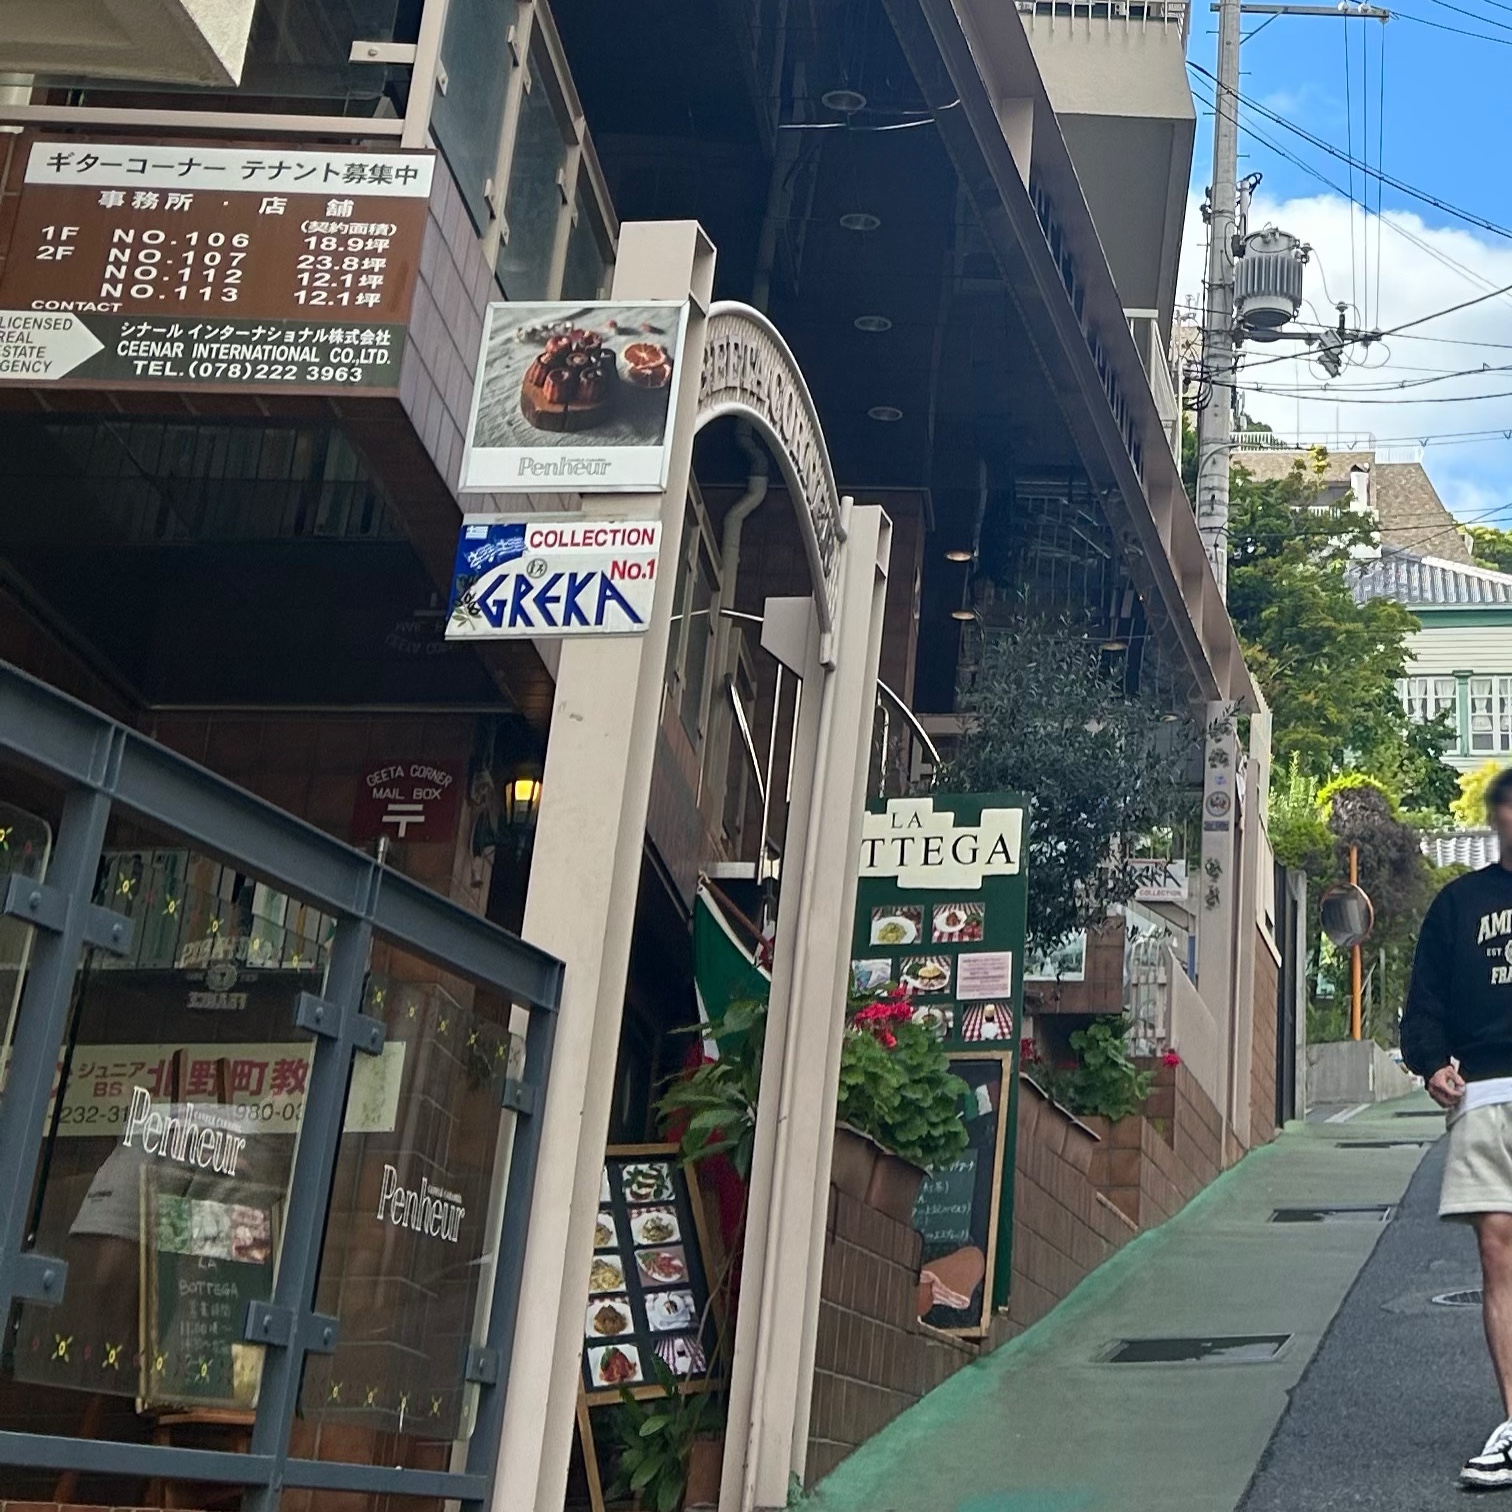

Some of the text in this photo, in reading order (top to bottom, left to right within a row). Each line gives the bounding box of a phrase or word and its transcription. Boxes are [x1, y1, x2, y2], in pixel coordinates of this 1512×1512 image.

[46, 152, 419, 186] ギターコーナー テナント募集中
[41, 226, 390, 253] 1F NO.106 18.9坪
[35, 245, 387, 272] 2F NO.107 23.8坪
[104, 265, 384, 289] NO.112 12.1坪
[31, 300, 123, 313] CONTACT
[100, 283, 381, 308] NO.113 12.1坪
[0, 316, 73, 331] LICENSED
[120, 321, 392, 346] シナール インターナショナル株式会社
[0, 345, 47, 359] STATE
[116, 339, 185, 358] CEENAR
[191, 341, 320, 363] INTERNATIONAL
[305, 365, 363, 383] 3963
[517, 456, 612, 476] Penheur
[529, 527, 655, 549] COLLECTION
[610, 558, 656, 580] No.1
[476, 569, 645, 629] GREKA
[366, 764, 453, 788] GEETA CORNER
[372, 787, 442, 800] MAIL BOX
[890, 810, 923, 830] LA
[1477, 908, 1512, 946] AMI
[1486, 947, 1502, 957] EST
[78, 1059, 147, 1079] ジュニア
[122, 1085, 247, 1176] Penheur
[377, 1164, 466, 1242] Penheur
